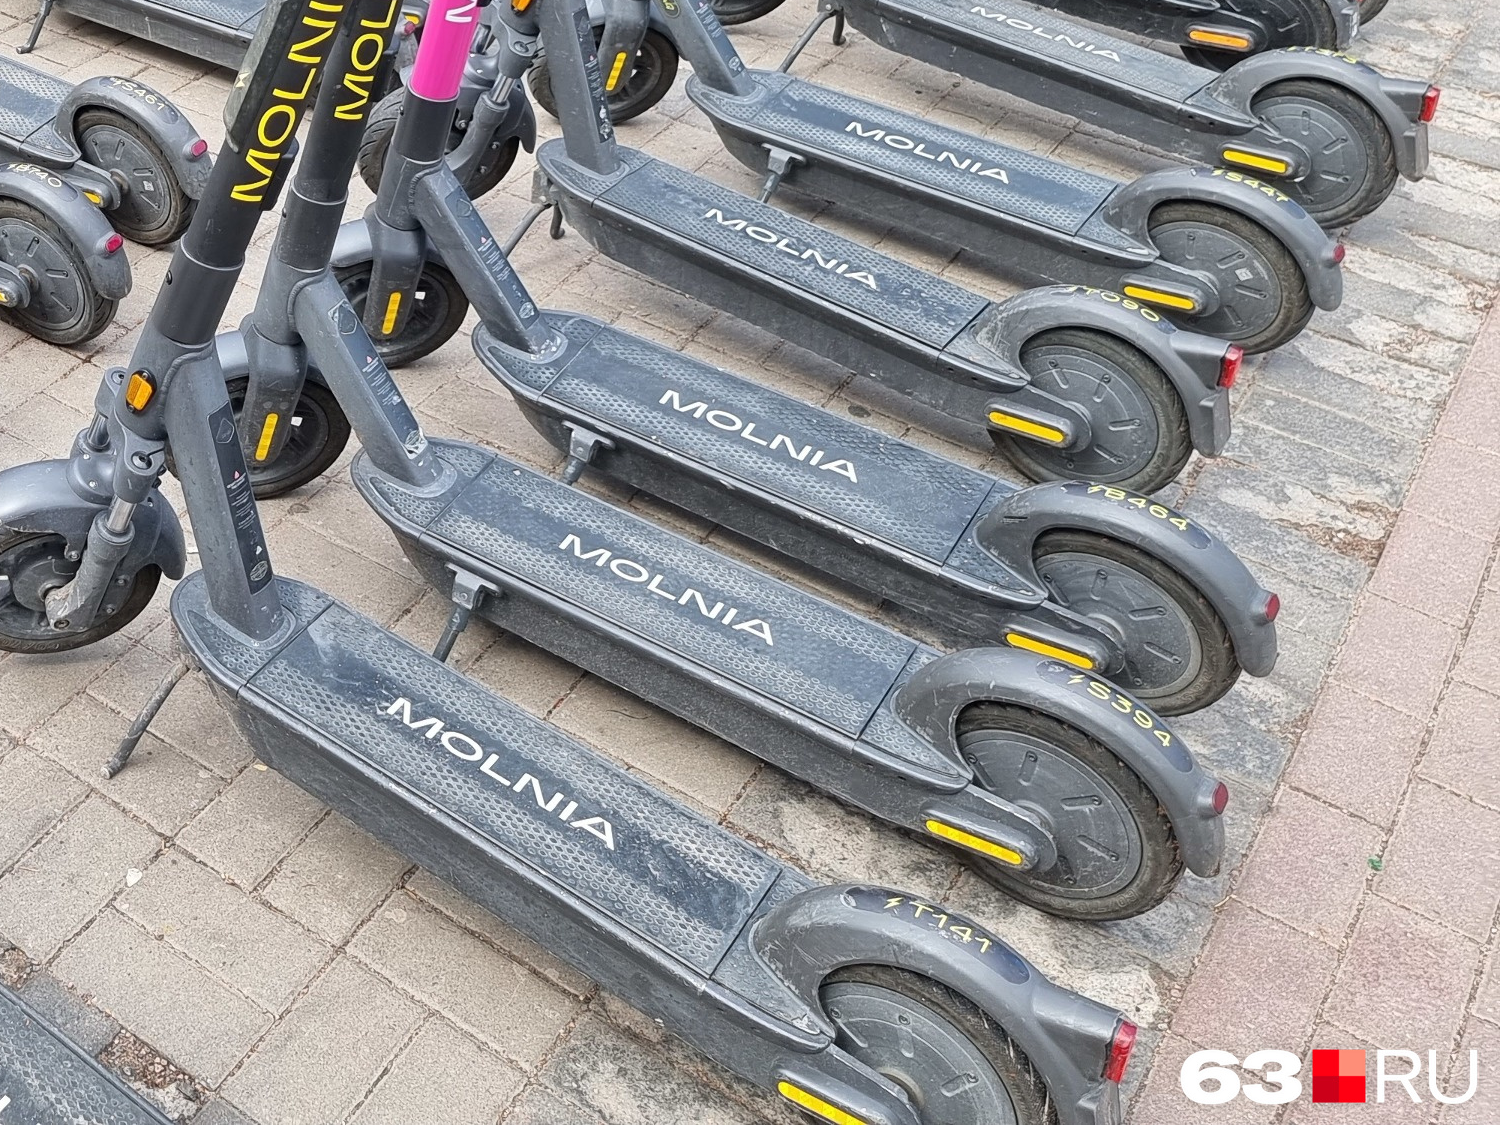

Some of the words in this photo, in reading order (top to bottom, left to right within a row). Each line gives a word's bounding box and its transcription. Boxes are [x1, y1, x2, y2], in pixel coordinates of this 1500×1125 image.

[970, 6, 1121, 63] MOLNIA
[844, 120, 1011, 185] MOLNIA
[704, 207, 879, 293] MOLNIA
[659, 389, 858, 483] MOLNIA
[1104, 483, 1190, 534] B464
[558, 533, 774, 647] MOLNIA
[1086, 675, 1173, 750] S394
[386, 697, 616, 851] MOLNIA
[908, 900, 994, 956] T141
